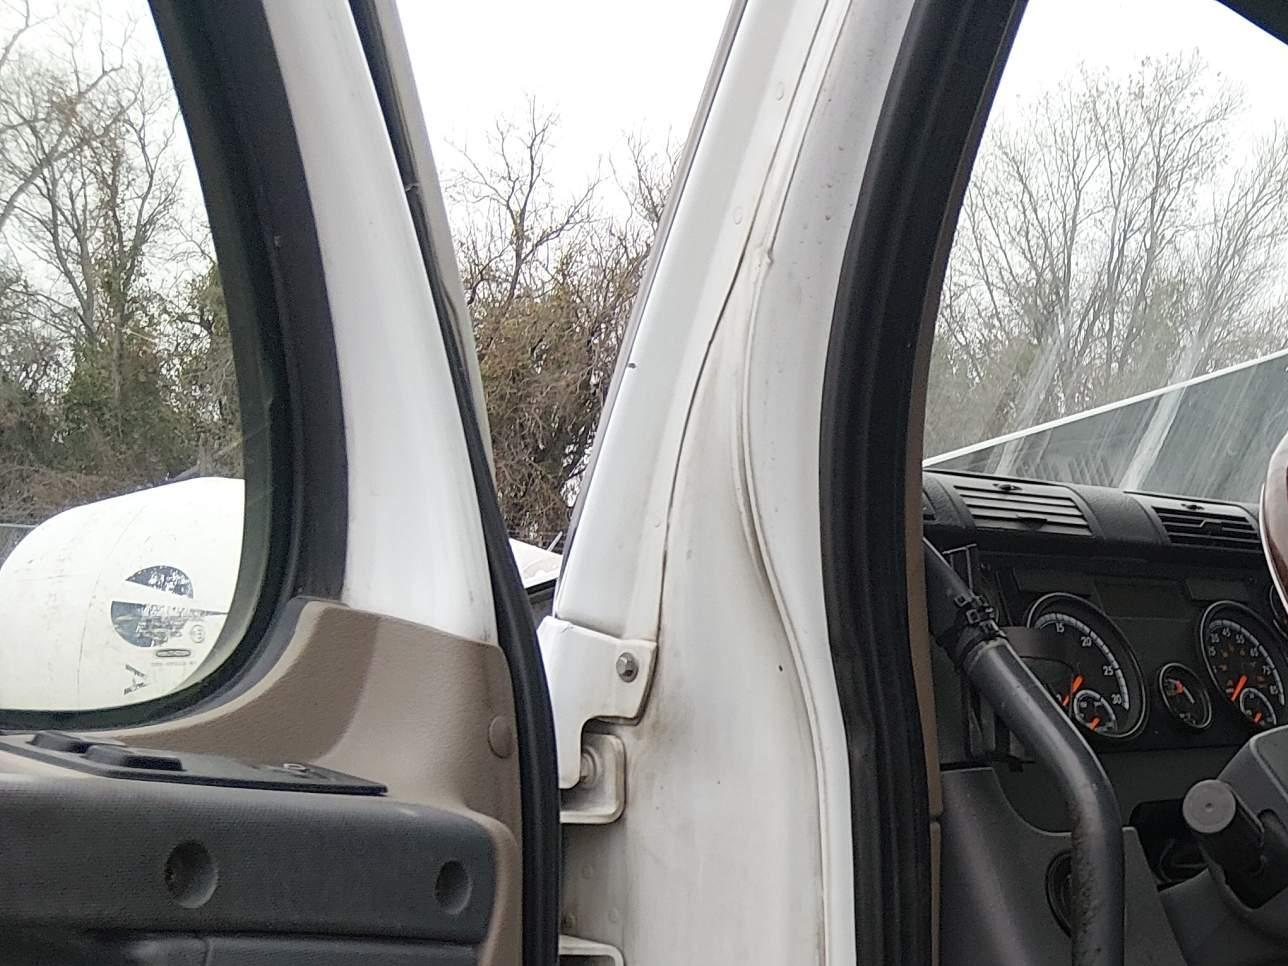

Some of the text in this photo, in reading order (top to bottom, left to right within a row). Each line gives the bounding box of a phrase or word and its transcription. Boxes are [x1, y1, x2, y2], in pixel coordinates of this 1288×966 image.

[1081, 637, 1092, 647] 20
[1103, 665, 1114, 676] 25
[1111, 694, 1122, 704] 30
